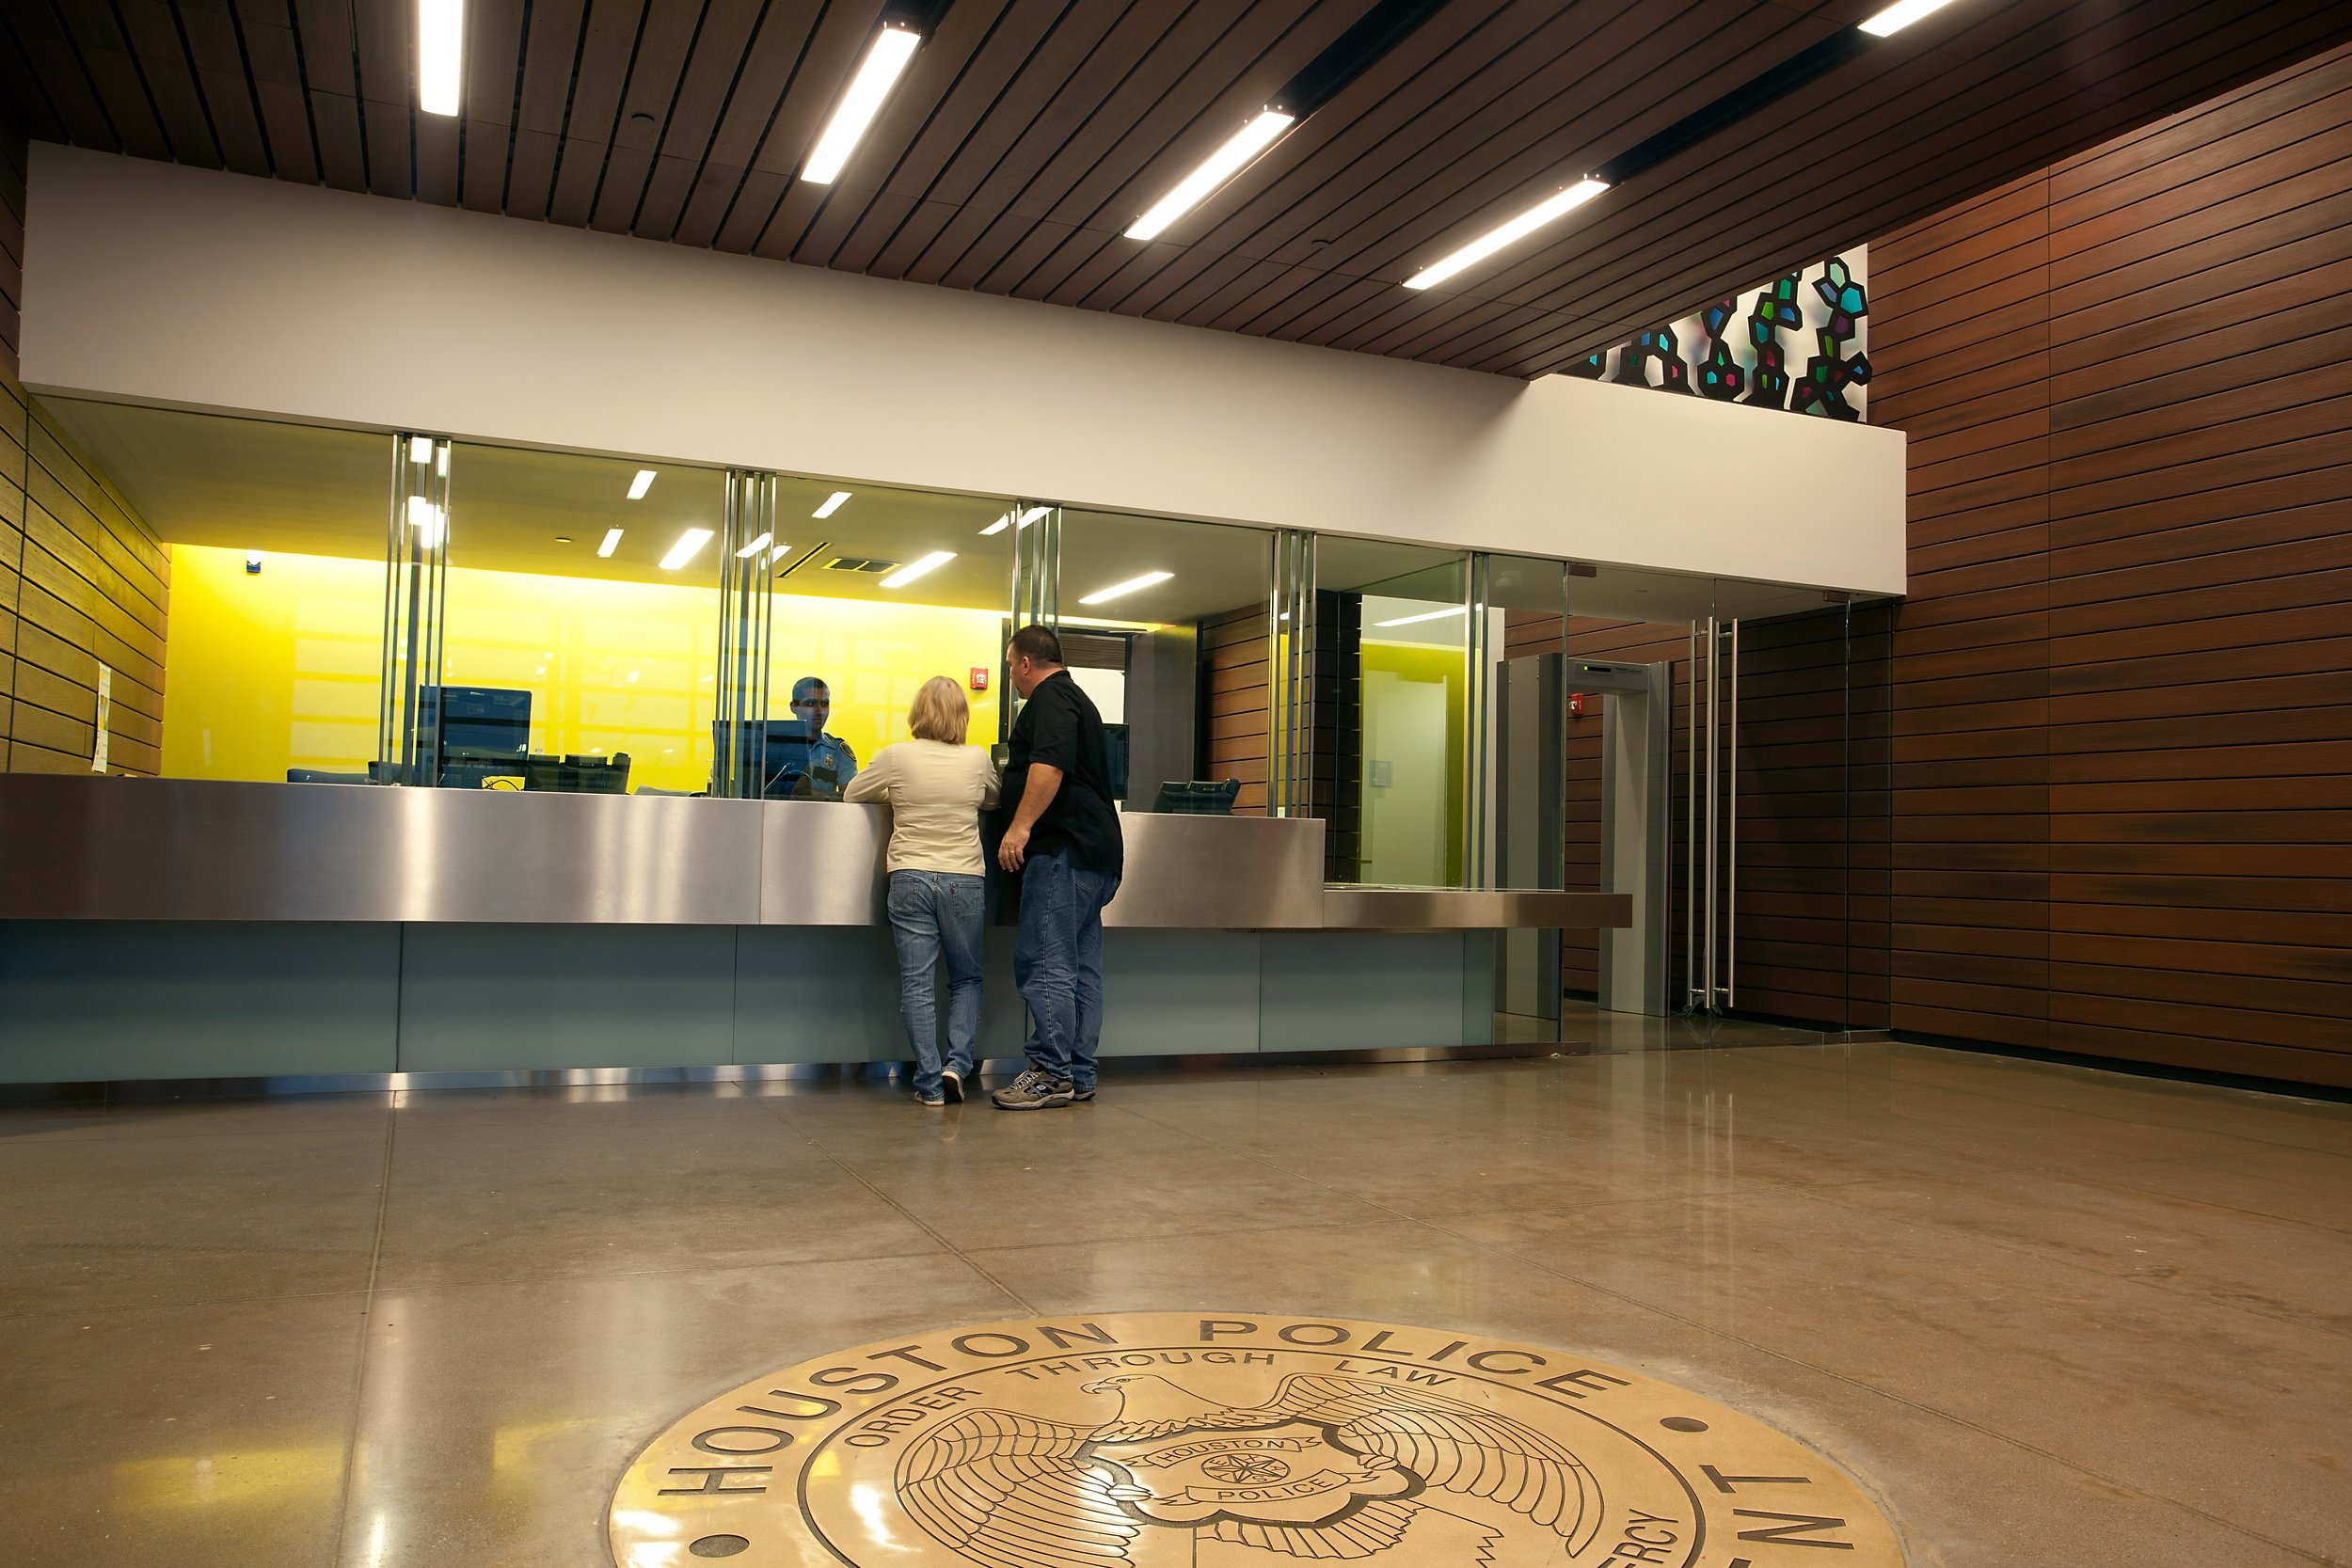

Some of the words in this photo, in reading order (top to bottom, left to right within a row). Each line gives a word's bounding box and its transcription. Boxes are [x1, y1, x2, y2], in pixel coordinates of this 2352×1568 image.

[659, 1322, 1119, 1497] HOUSTON
[1200, 1320, 1631, 1399] POLICE
[845, 1386, 982, 1448] ORDER
[1004, 1351, 1276, 1381] THROUGH
[1332, 1360, 1457, 1386] LAW
[1155, 1439, 1285, 1463] HOUSTON
[1217, 1478, 1332, 1500] POLICE
